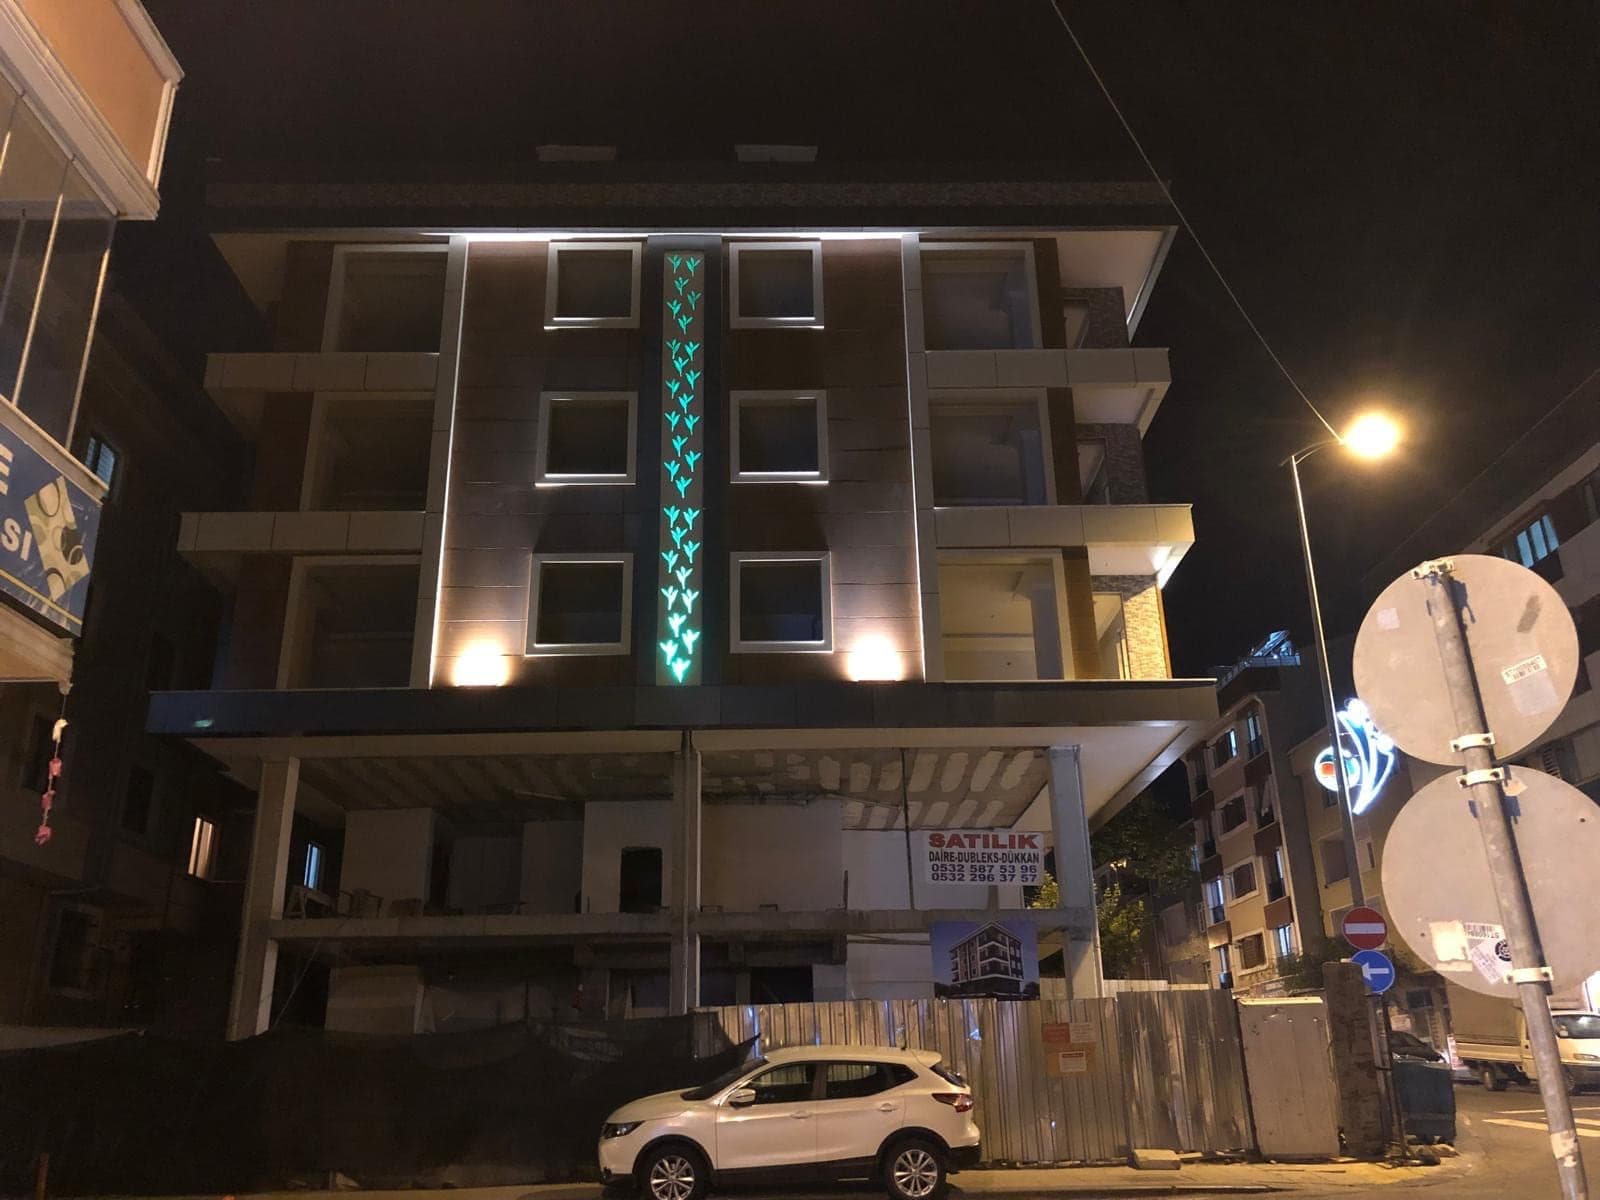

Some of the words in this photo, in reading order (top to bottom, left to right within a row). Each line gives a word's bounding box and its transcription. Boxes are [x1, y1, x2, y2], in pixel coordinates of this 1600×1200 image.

[928, 832, 1039, 850] SATILIK
[931, 863, 965, 873] 0532
[969, 864, 994, 874] 587
[999, 865, 1016, 874] 53
[1020, 865, 1037, 874] 96
[931, 872, 965, 882] 0532
[969, 873, 995, 883] 296
[999, 873, 1016, 883] 37
[1020, 874, 1037, 883] 57
